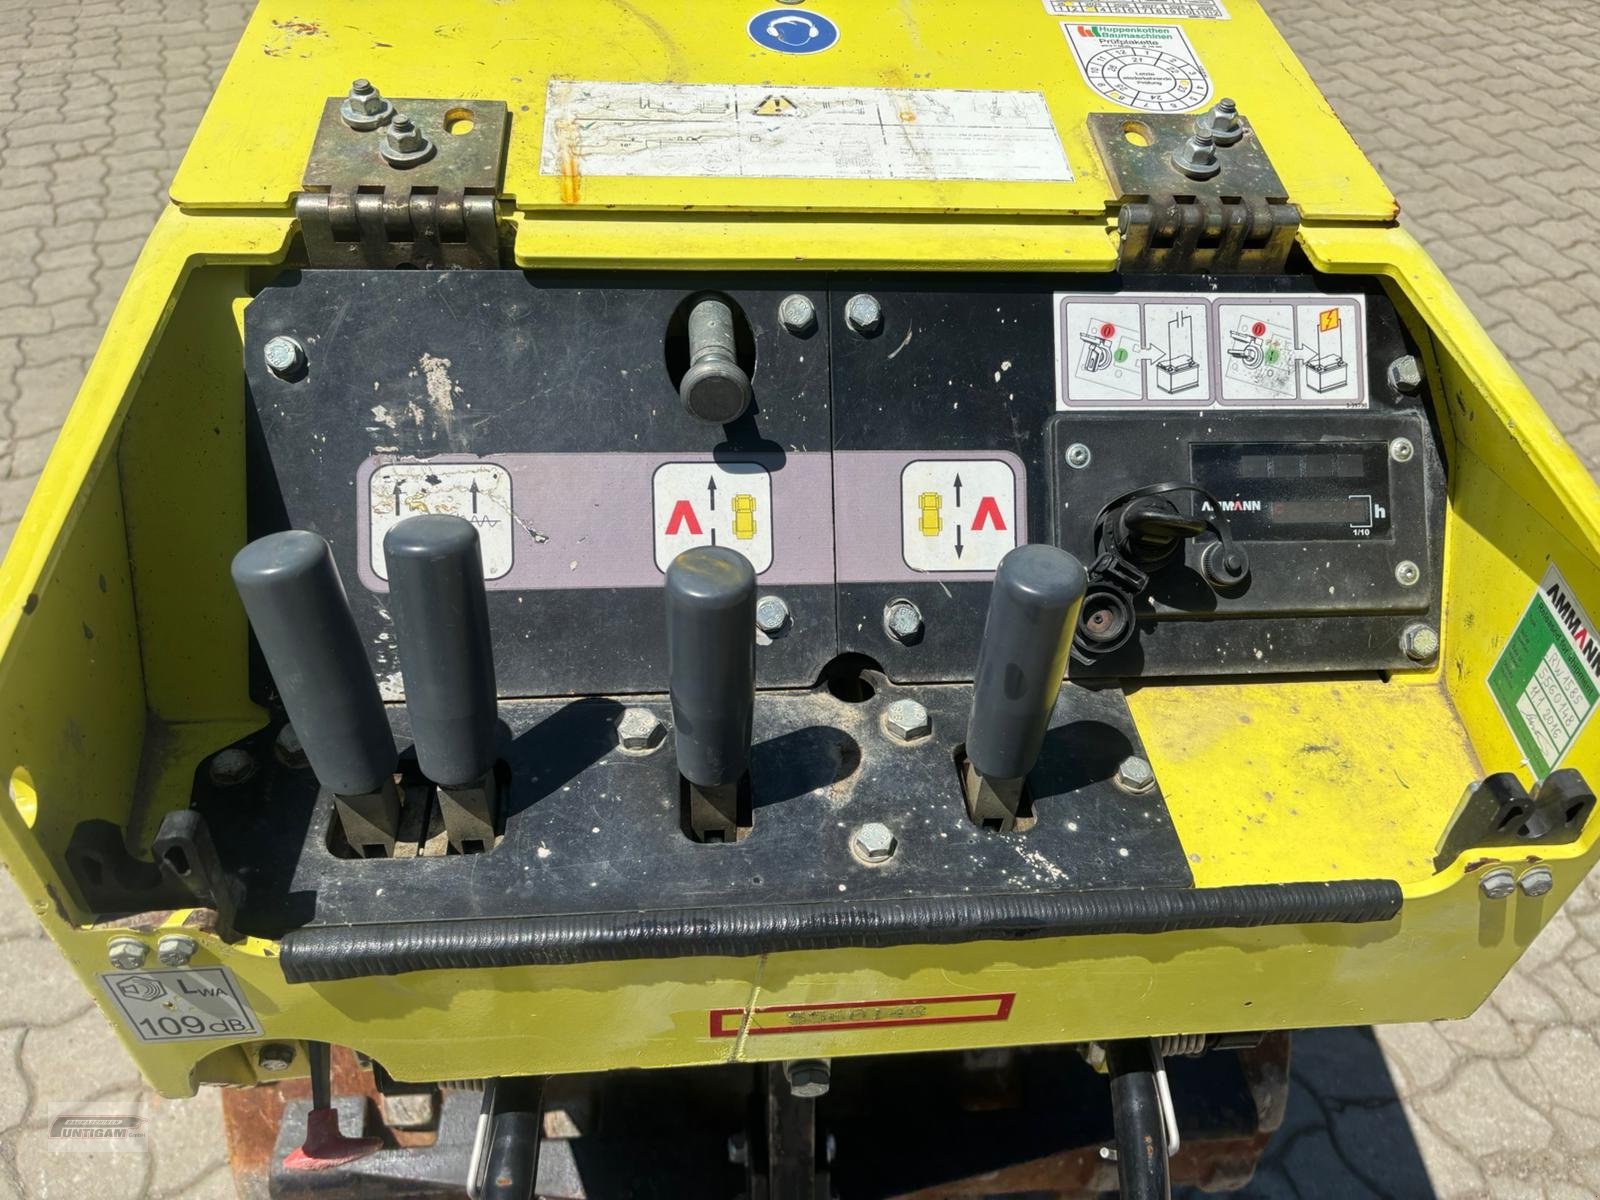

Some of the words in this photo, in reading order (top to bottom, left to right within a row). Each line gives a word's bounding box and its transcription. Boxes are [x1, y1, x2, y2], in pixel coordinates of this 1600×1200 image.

[1099, 26, 1169, 34] Huppenkothen
[1201, 501, 1261, 512] AMANN
[1374, 503, 1386, 518] h
[1352, 528, 1370, 536] 1/10
[139, 1015, 205, 1037] 109
[209, 1018, 246, 1033] dB
